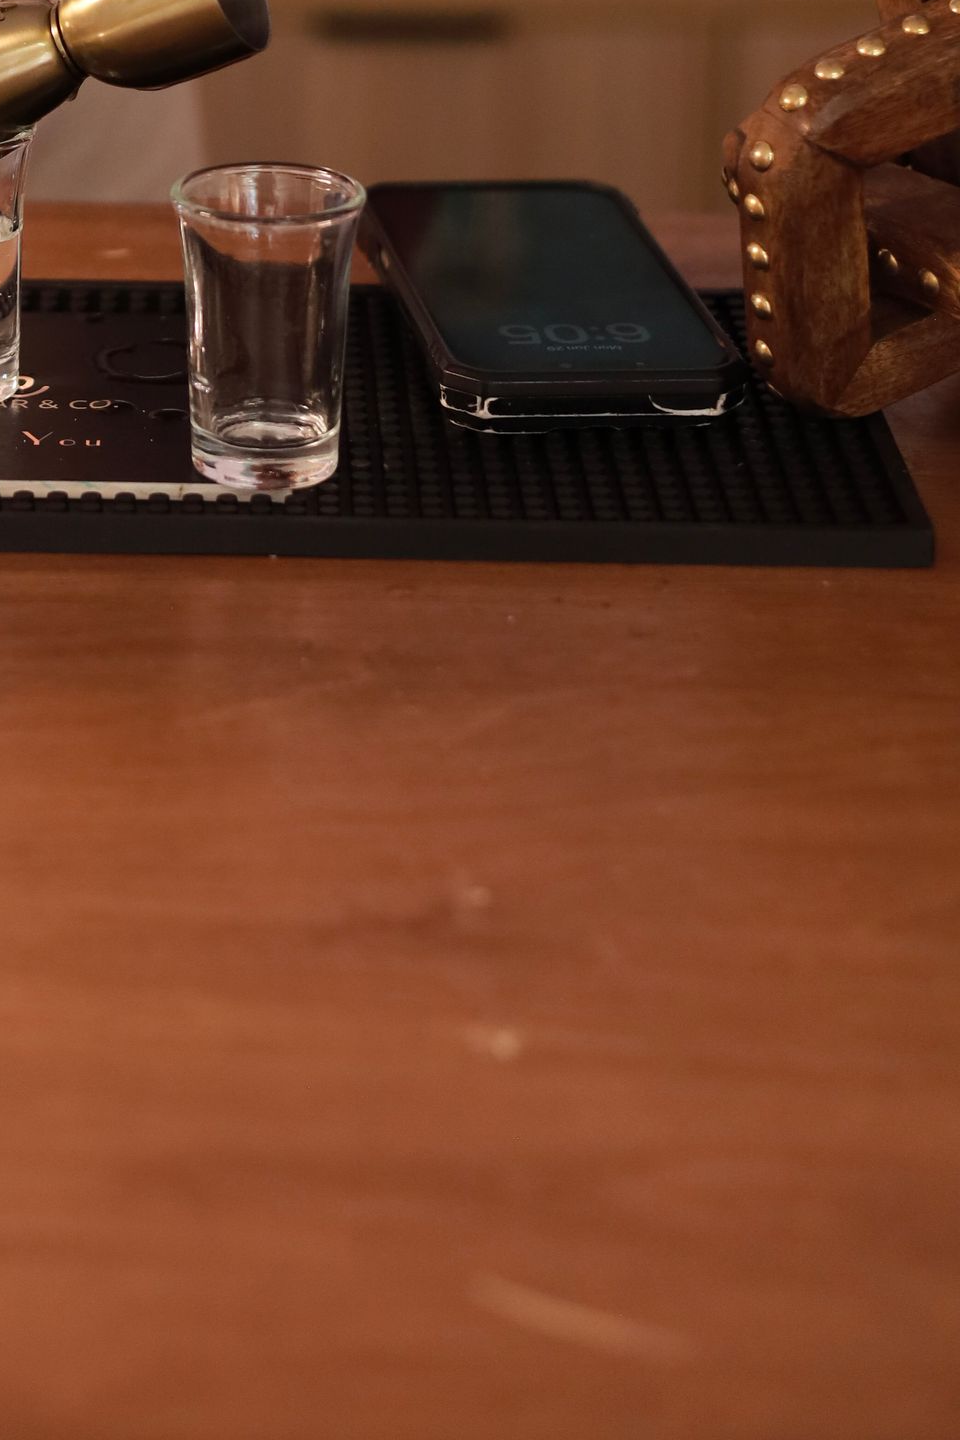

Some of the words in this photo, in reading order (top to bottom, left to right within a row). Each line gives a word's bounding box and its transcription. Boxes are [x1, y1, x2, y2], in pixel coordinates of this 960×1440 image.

[498, 322, 651, 345] 6:05
[38, 399, 58, 410] &
[21, 430, 102, 448] You
